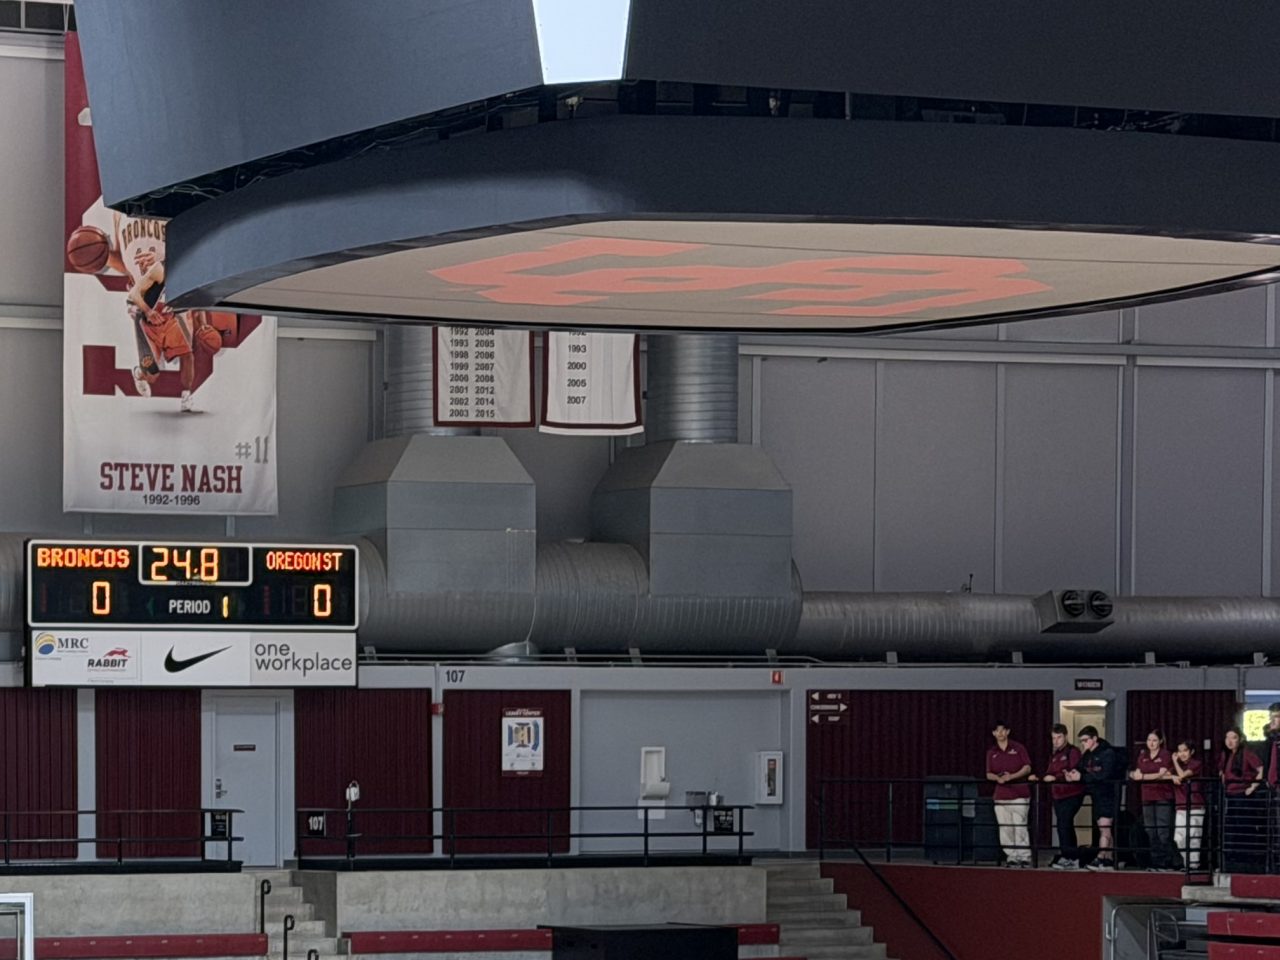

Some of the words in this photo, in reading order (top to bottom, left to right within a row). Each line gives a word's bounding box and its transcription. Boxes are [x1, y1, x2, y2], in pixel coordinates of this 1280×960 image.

[475, 362, 495, 371] 2007
[475, 386, 495, 394] 2012
[475, 397, 495, 406] 2014
[567, 395, 587, 405] 2007
[475, 409, 495, 418] 2015
[235, 435, 270, 464] #11
[100, 462, 175, 492] STEVE
[181, 464, 243, 493] NASH
[142, 494, 201, 505] 1992-1996
[37, 548, 130, 568] BRONCOS
[151, 547, 219, 581] 24.8
[92, 581, 110, 615] 0
[313, 584, 331, 617] 0
[169, 599, 211, 614] PERIOD
[223, 595, 229, 618] 1
[58, 637, 89, 649] MRC
[255, 643, 290, 656] one
[87, 658, 129, 668] RABBIT
[255, 651, 352, 677] workplace
[446, 670, 465, 683] 107
[308, 816, 324, 831] 107
